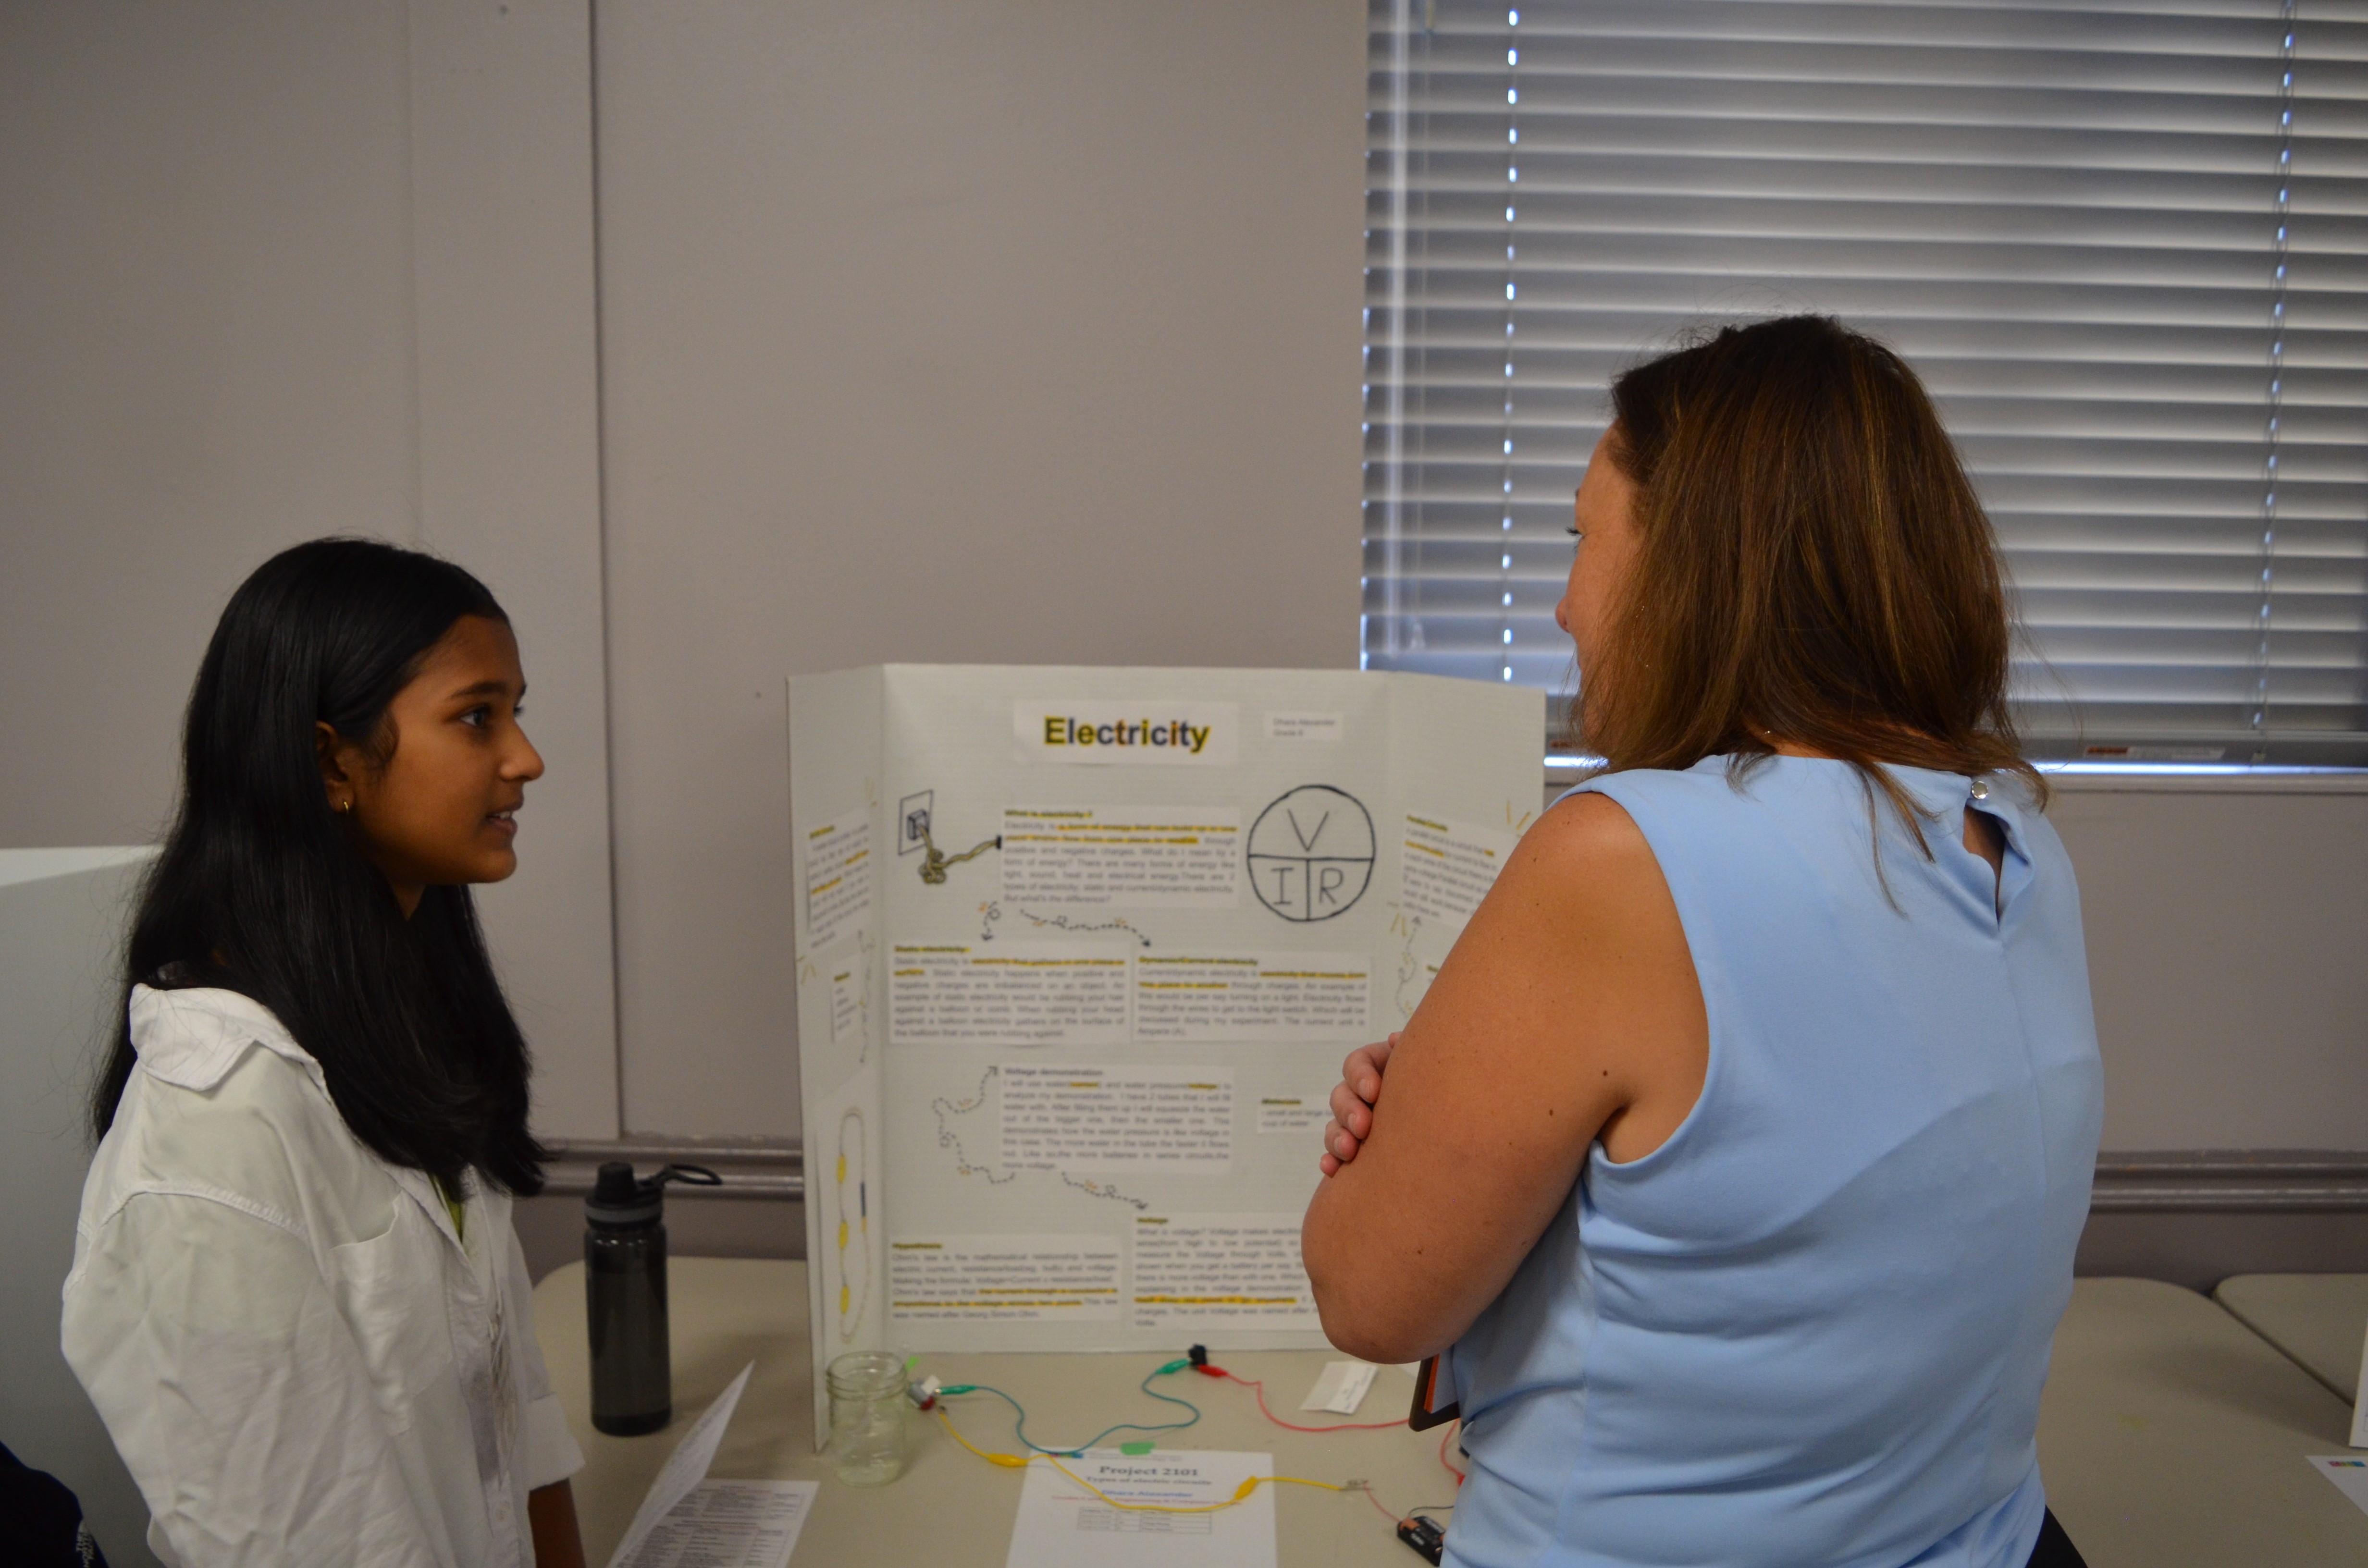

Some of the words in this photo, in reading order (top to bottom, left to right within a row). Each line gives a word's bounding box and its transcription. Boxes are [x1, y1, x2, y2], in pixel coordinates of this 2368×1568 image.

[1044, 716, 1211, 754] Electricity
[1299, 718, 1335, 726] Alexander
[1287, 808, 1329, 852] V
[1271, 867, 1295, 905] I
[1319, 867, 1344, 905] R
[1099, 1467, 1157, 1476] Project
[1163, 1468, 1197, 1477] 2101
